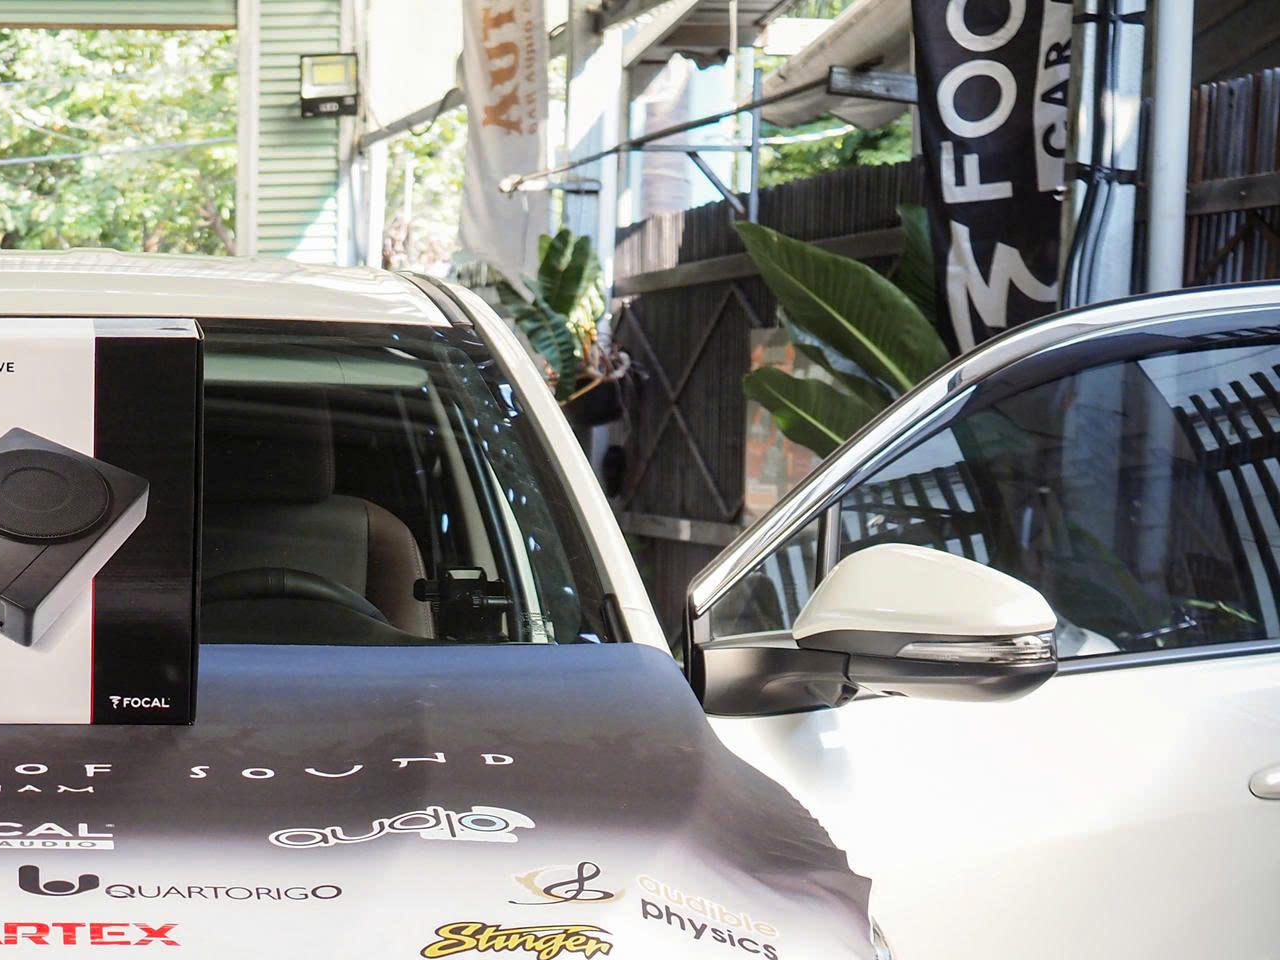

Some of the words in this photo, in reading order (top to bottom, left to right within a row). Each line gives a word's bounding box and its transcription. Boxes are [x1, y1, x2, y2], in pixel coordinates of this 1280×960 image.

[14, 763, 113, 778] OF
[189, 751, 516, 780] SOUND
[104, 883, 344, 901] QUARTORIGO
[634, 872, 781, 939] audible
